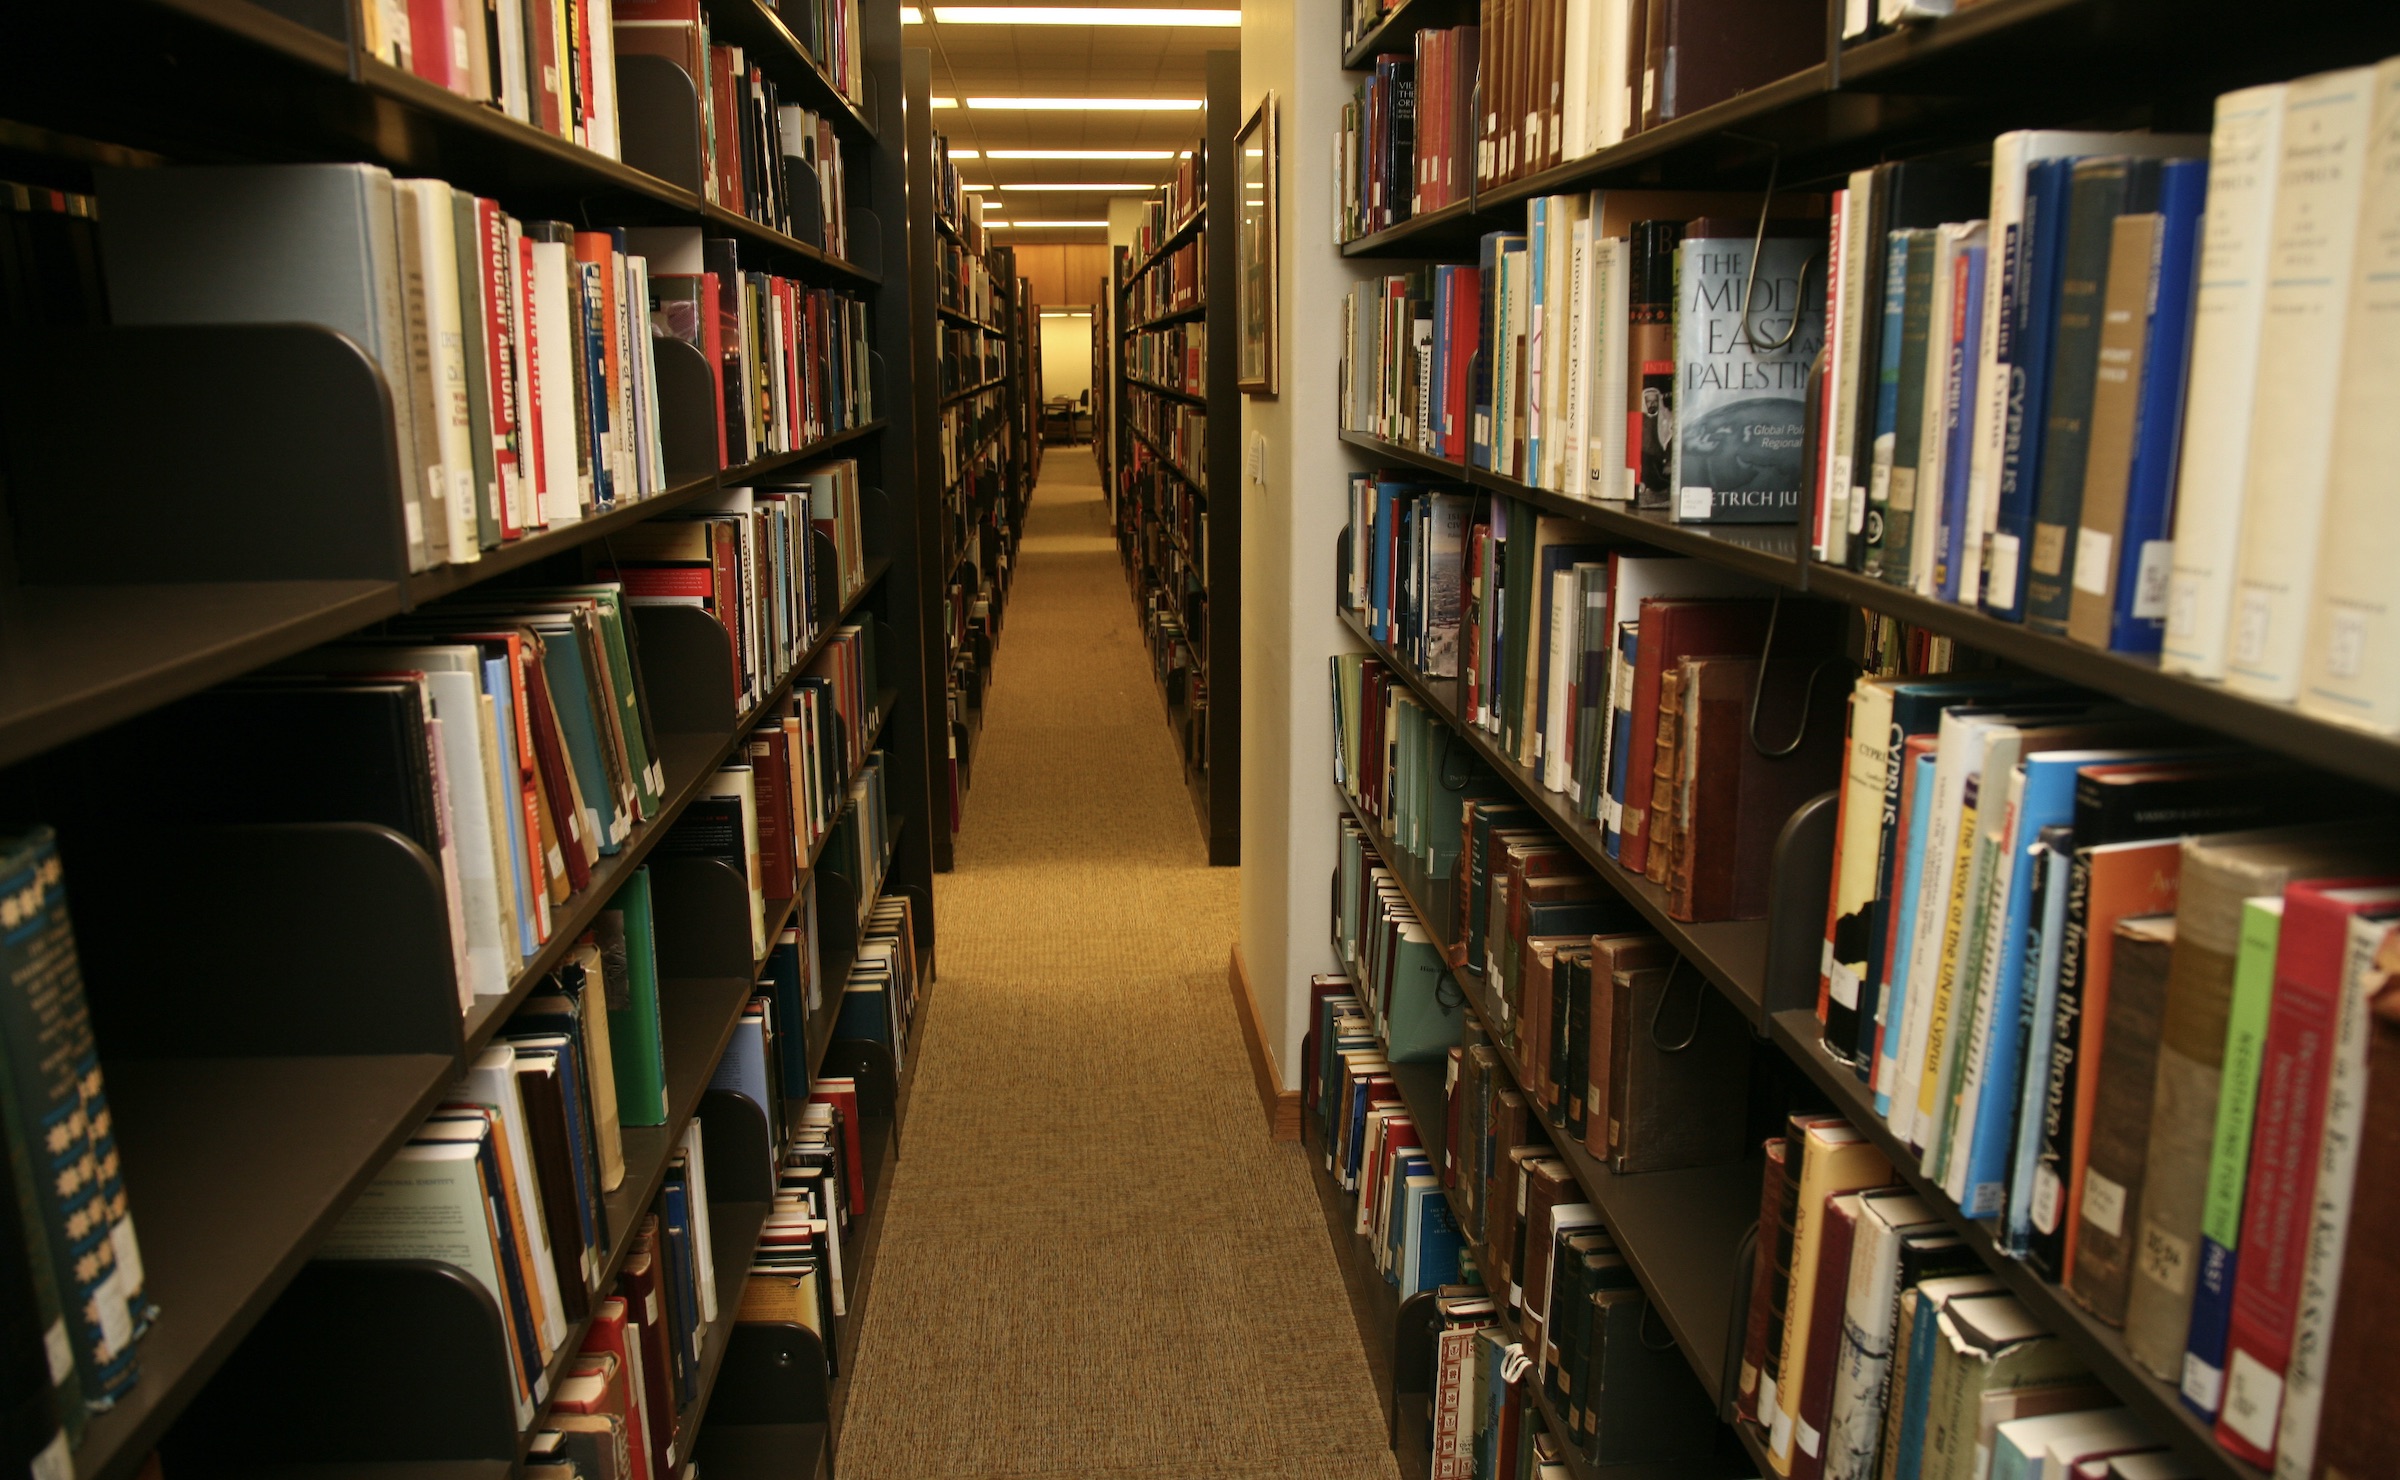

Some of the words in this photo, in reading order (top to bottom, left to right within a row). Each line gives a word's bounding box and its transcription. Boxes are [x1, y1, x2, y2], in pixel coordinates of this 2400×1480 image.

[1849, 200, 1860, 252] RIDING
[490, 211, 508, 327] INNOCENT
[1573, 247, 1583, 309] MIDDLE
[1695, 253, 1743, 275] THE
[1827, 213, 1840, 293] ROMAN
[527, 269, 538, 338] SOWING
[1692, 278, 1824, 313] MIDDL
[1847, 281, 1856, 310] THE
[620, 303, 630, 360] Decade
[1571, 314, 1581, 349] EAST
[1709, 319, 1806, 355] EAST
[1805, 337, 1826, 352] AN
[1822, 299, 1836, 374] EDESSA
[1843, 315, 1854, 364] TIGRIS
[497, 333, 514, 422] ABROAD
[531, 346, 541, 406] CRISIS
[622, 364, 630, 380] of
[1568, 358, 1579, 430] PATTERNS
[1688, 361, 1812, 390] PALESTIN
[1947, 347, 1964, 429] CYPRUS
[624, 386, 635, 454] Decision
[1753, 424, 1785, 436] Global
[1761, 437, 1803, 450] Regional
[2002, 366, 2026, 494] CYPRUS
[1711, 491, 1773, 507] ETRICH
[1778, 491, 1798, 507] JU
[1858, 742, 1888, 765] CYPR
[1881, 722, 1905, 827] CYPRUS
[1961, 818, 1977, 850] The
[1954, 855, 1972, 900] Work
[2068, 848, 2093, 920] View
[1950, 905, 1964, 928] of
[1946, 930, 1963, 960] the
[2058, 922, 2088, 987] from
[1940, 962, 1958, 994] UN
[1937, 995, 1954, 1014] in
[2058, 993, 2080, 1040] the
[1927, 1016, 1950, 1076] Cyprus
[2044, 1043, 2073, 1137] Bronze
[2203, 1243, 2227, 1295] PAST
[1785, 1275, 1799, 1339] DESERT
